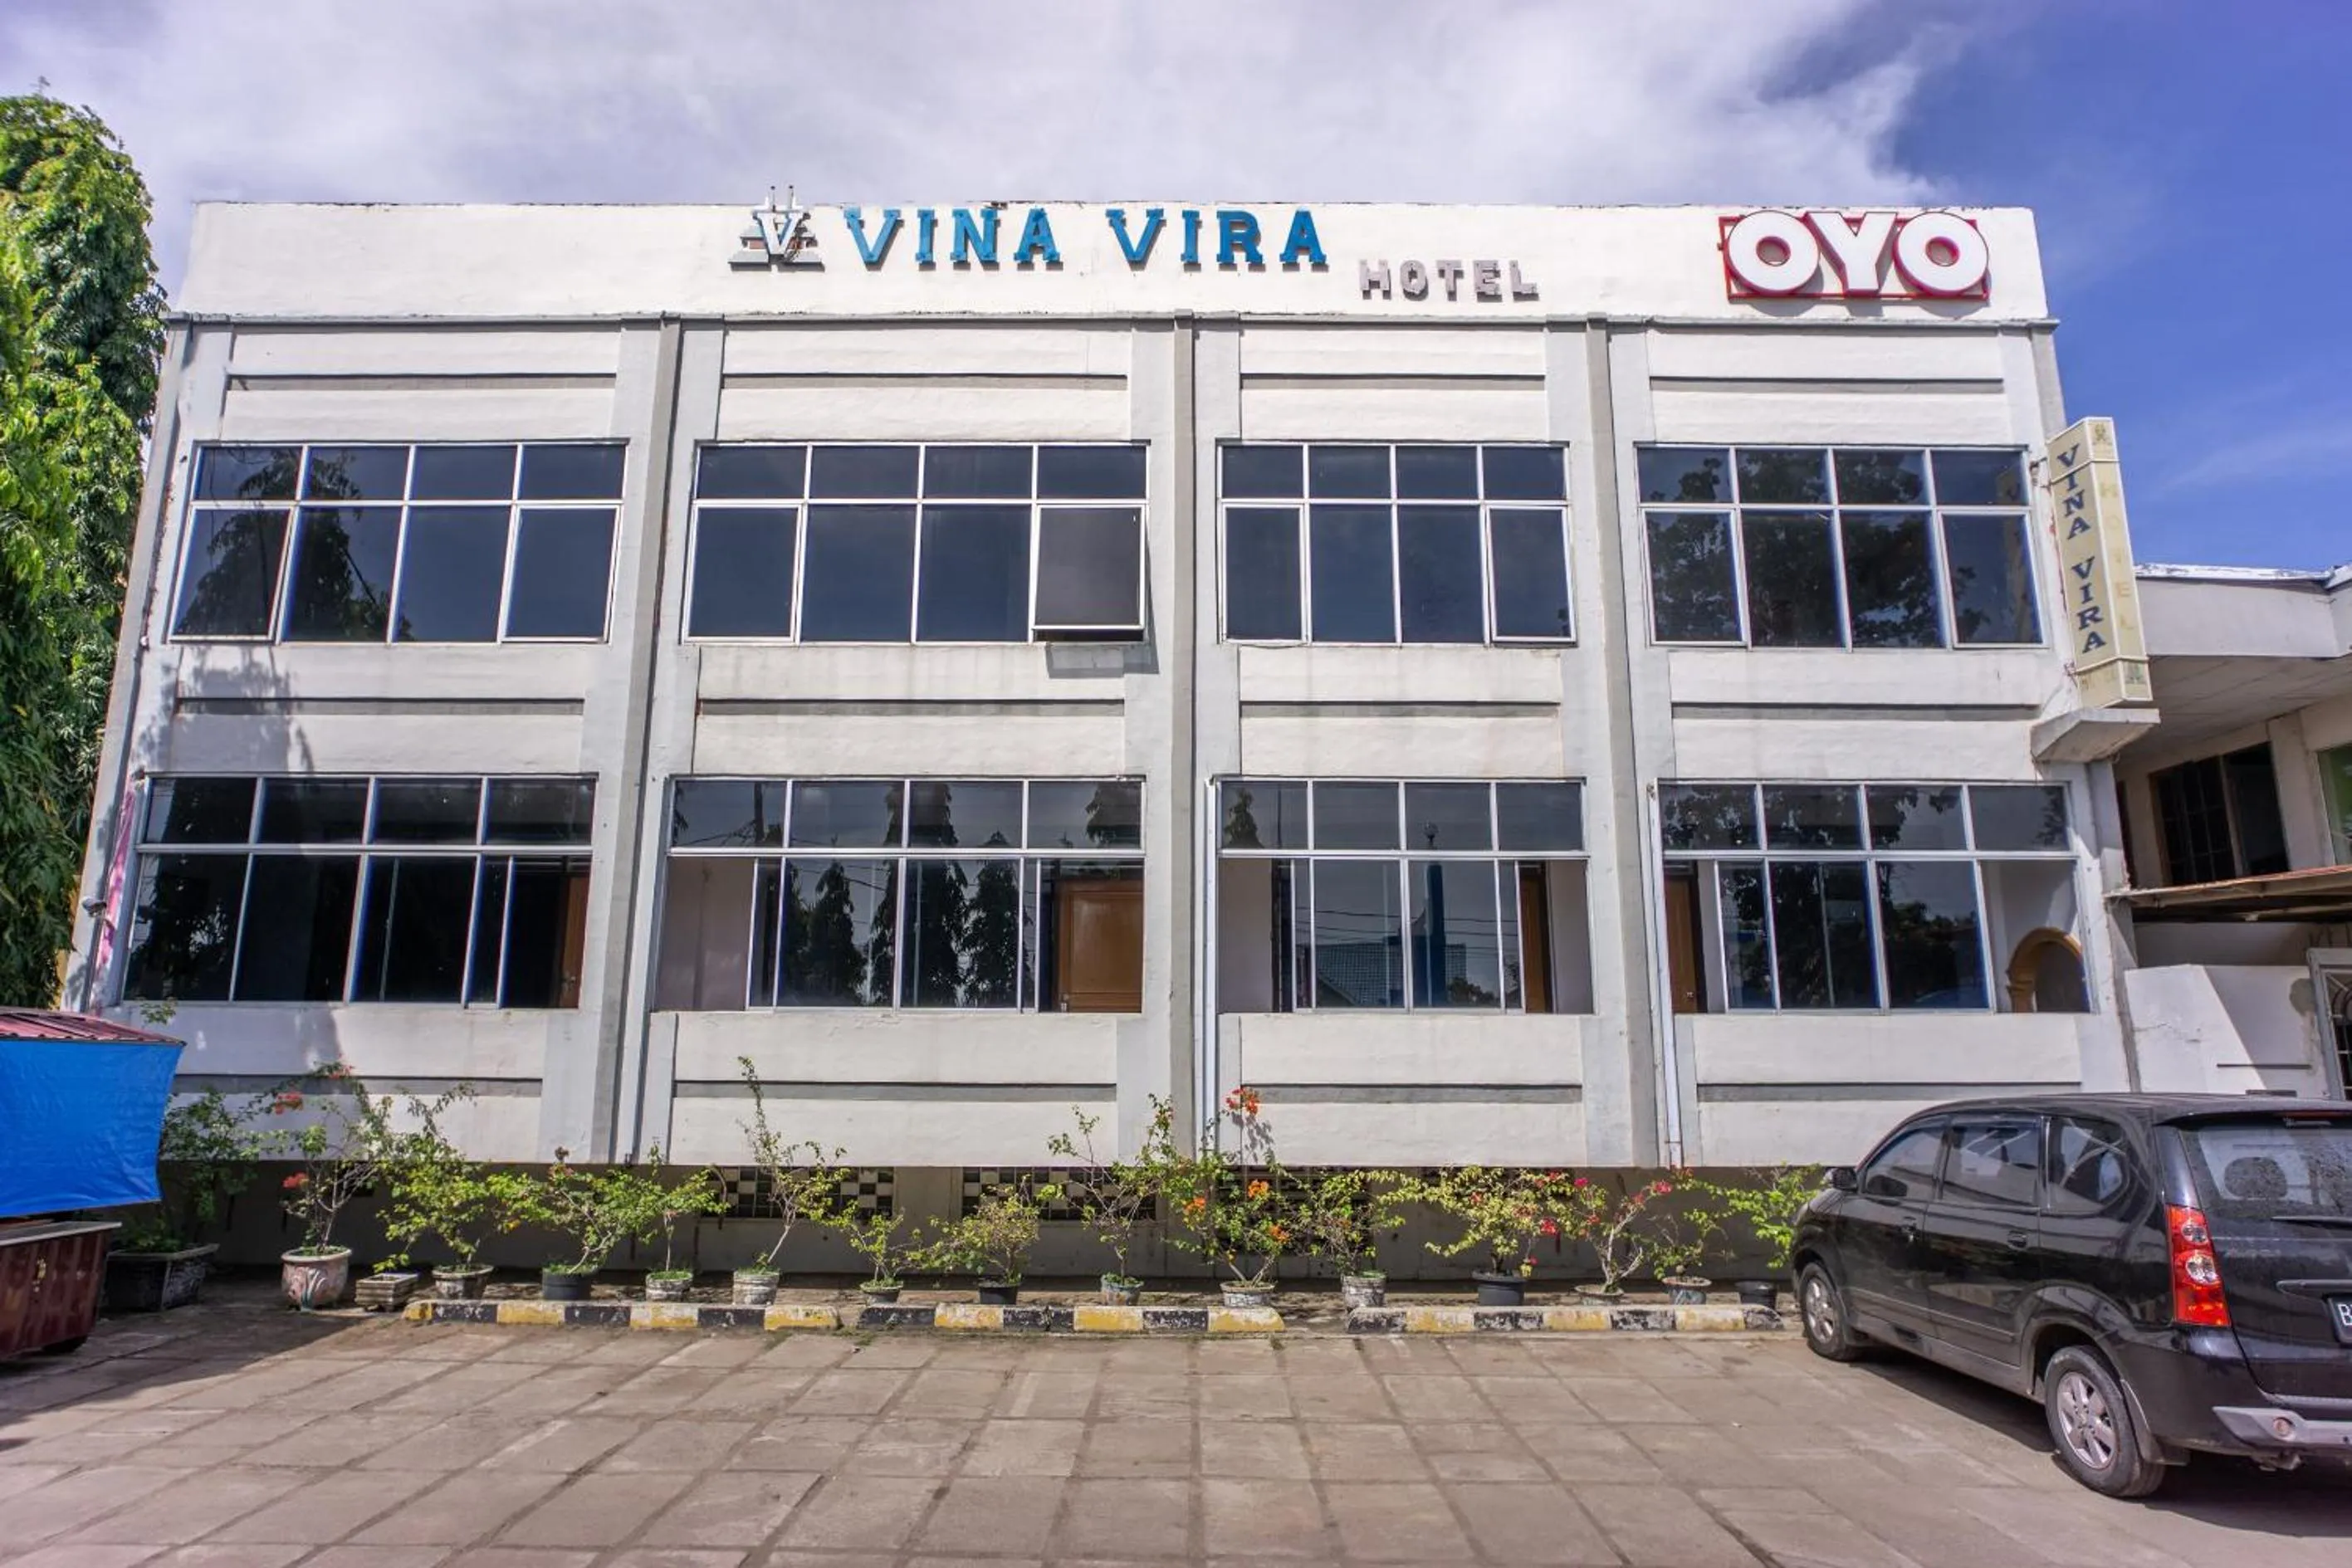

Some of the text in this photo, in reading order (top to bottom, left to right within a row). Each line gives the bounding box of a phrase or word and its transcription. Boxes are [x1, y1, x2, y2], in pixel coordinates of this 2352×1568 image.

[843, 207, 1327, 265] VINA VIRA
[1358, 259, 1540, 300] HOTEL
[1724, 209, 1989, 297] OYO
[2056, 443, 2092, 540] VINA
[2071, 555, 2107, 654] VIRA
